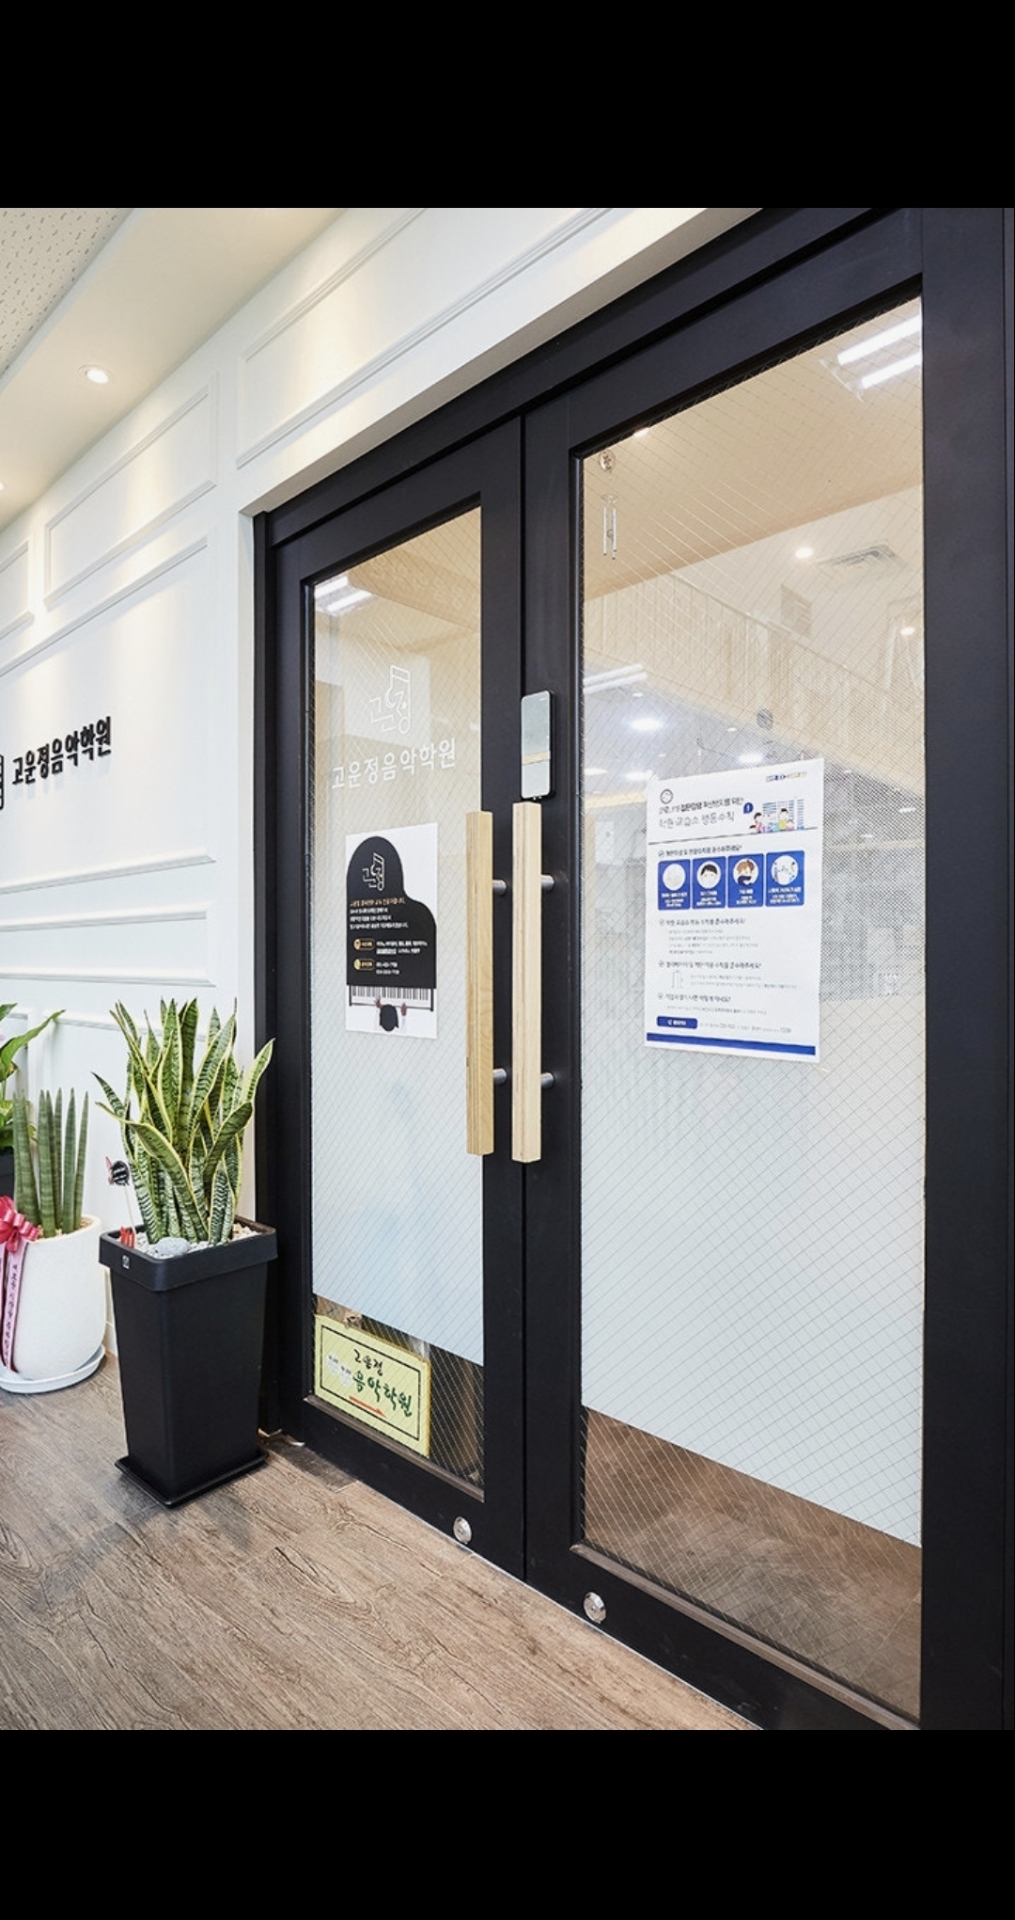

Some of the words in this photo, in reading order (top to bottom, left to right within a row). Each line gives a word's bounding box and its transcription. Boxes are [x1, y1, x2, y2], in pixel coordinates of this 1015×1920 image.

[12, 715, 112, 785] 고운정음악학원
[331, 736, 456, 790] 고운정음악학원
[352, 1370, 413, 1418] 음악학원
